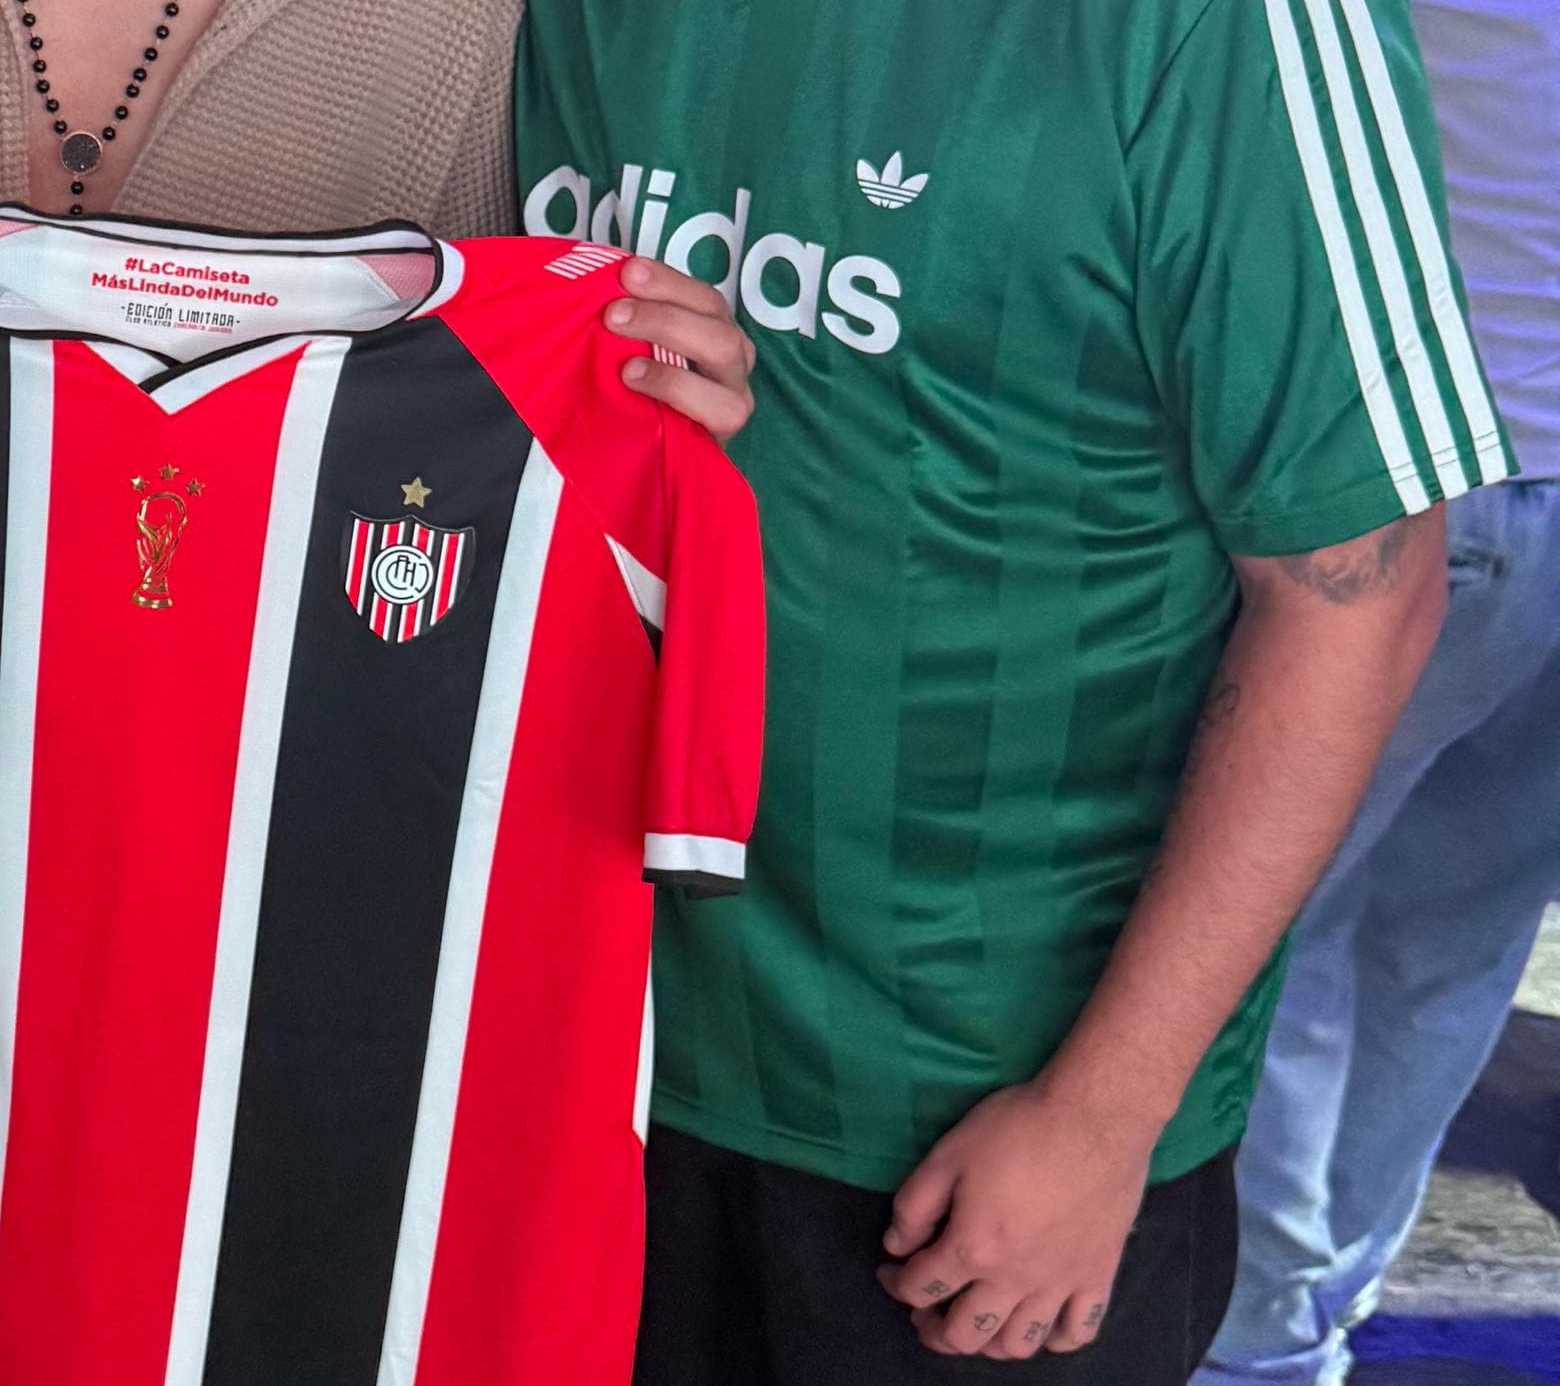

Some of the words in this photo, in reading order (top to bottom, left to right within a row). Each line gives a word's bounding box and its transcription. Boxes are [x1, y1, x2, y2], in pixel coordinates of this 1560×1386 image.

[123, 256, 250, 286] #LaCamiseta
[523, 163, 902, 355] adidas
[90, 272, 279, 308] MásLindaDelMundo
